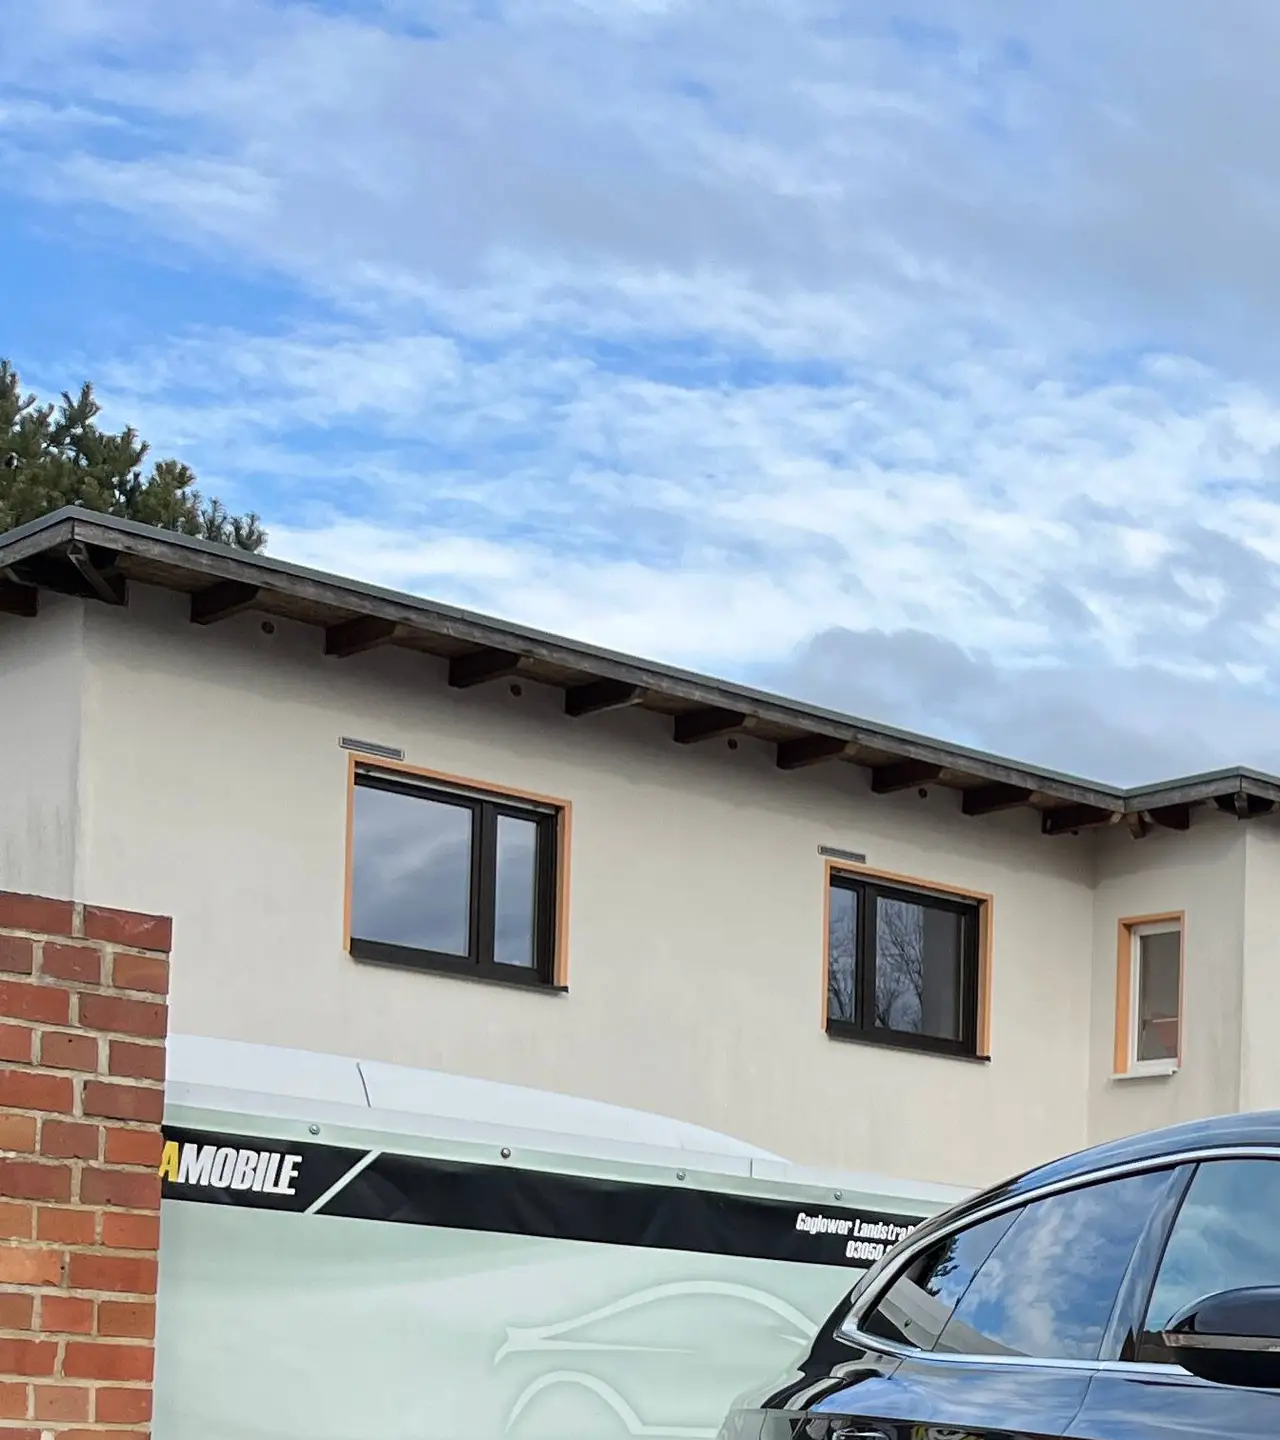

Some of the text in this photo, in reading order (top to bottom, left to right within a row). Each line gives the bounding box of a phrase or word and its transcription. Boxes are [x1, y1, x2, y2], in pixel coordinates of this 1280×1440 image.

[158, 1140, 302, 1196] AMOBILE
[795, 1212, 853, 1236] Gaglower
[846, 1240, 884, 1260] 03050
